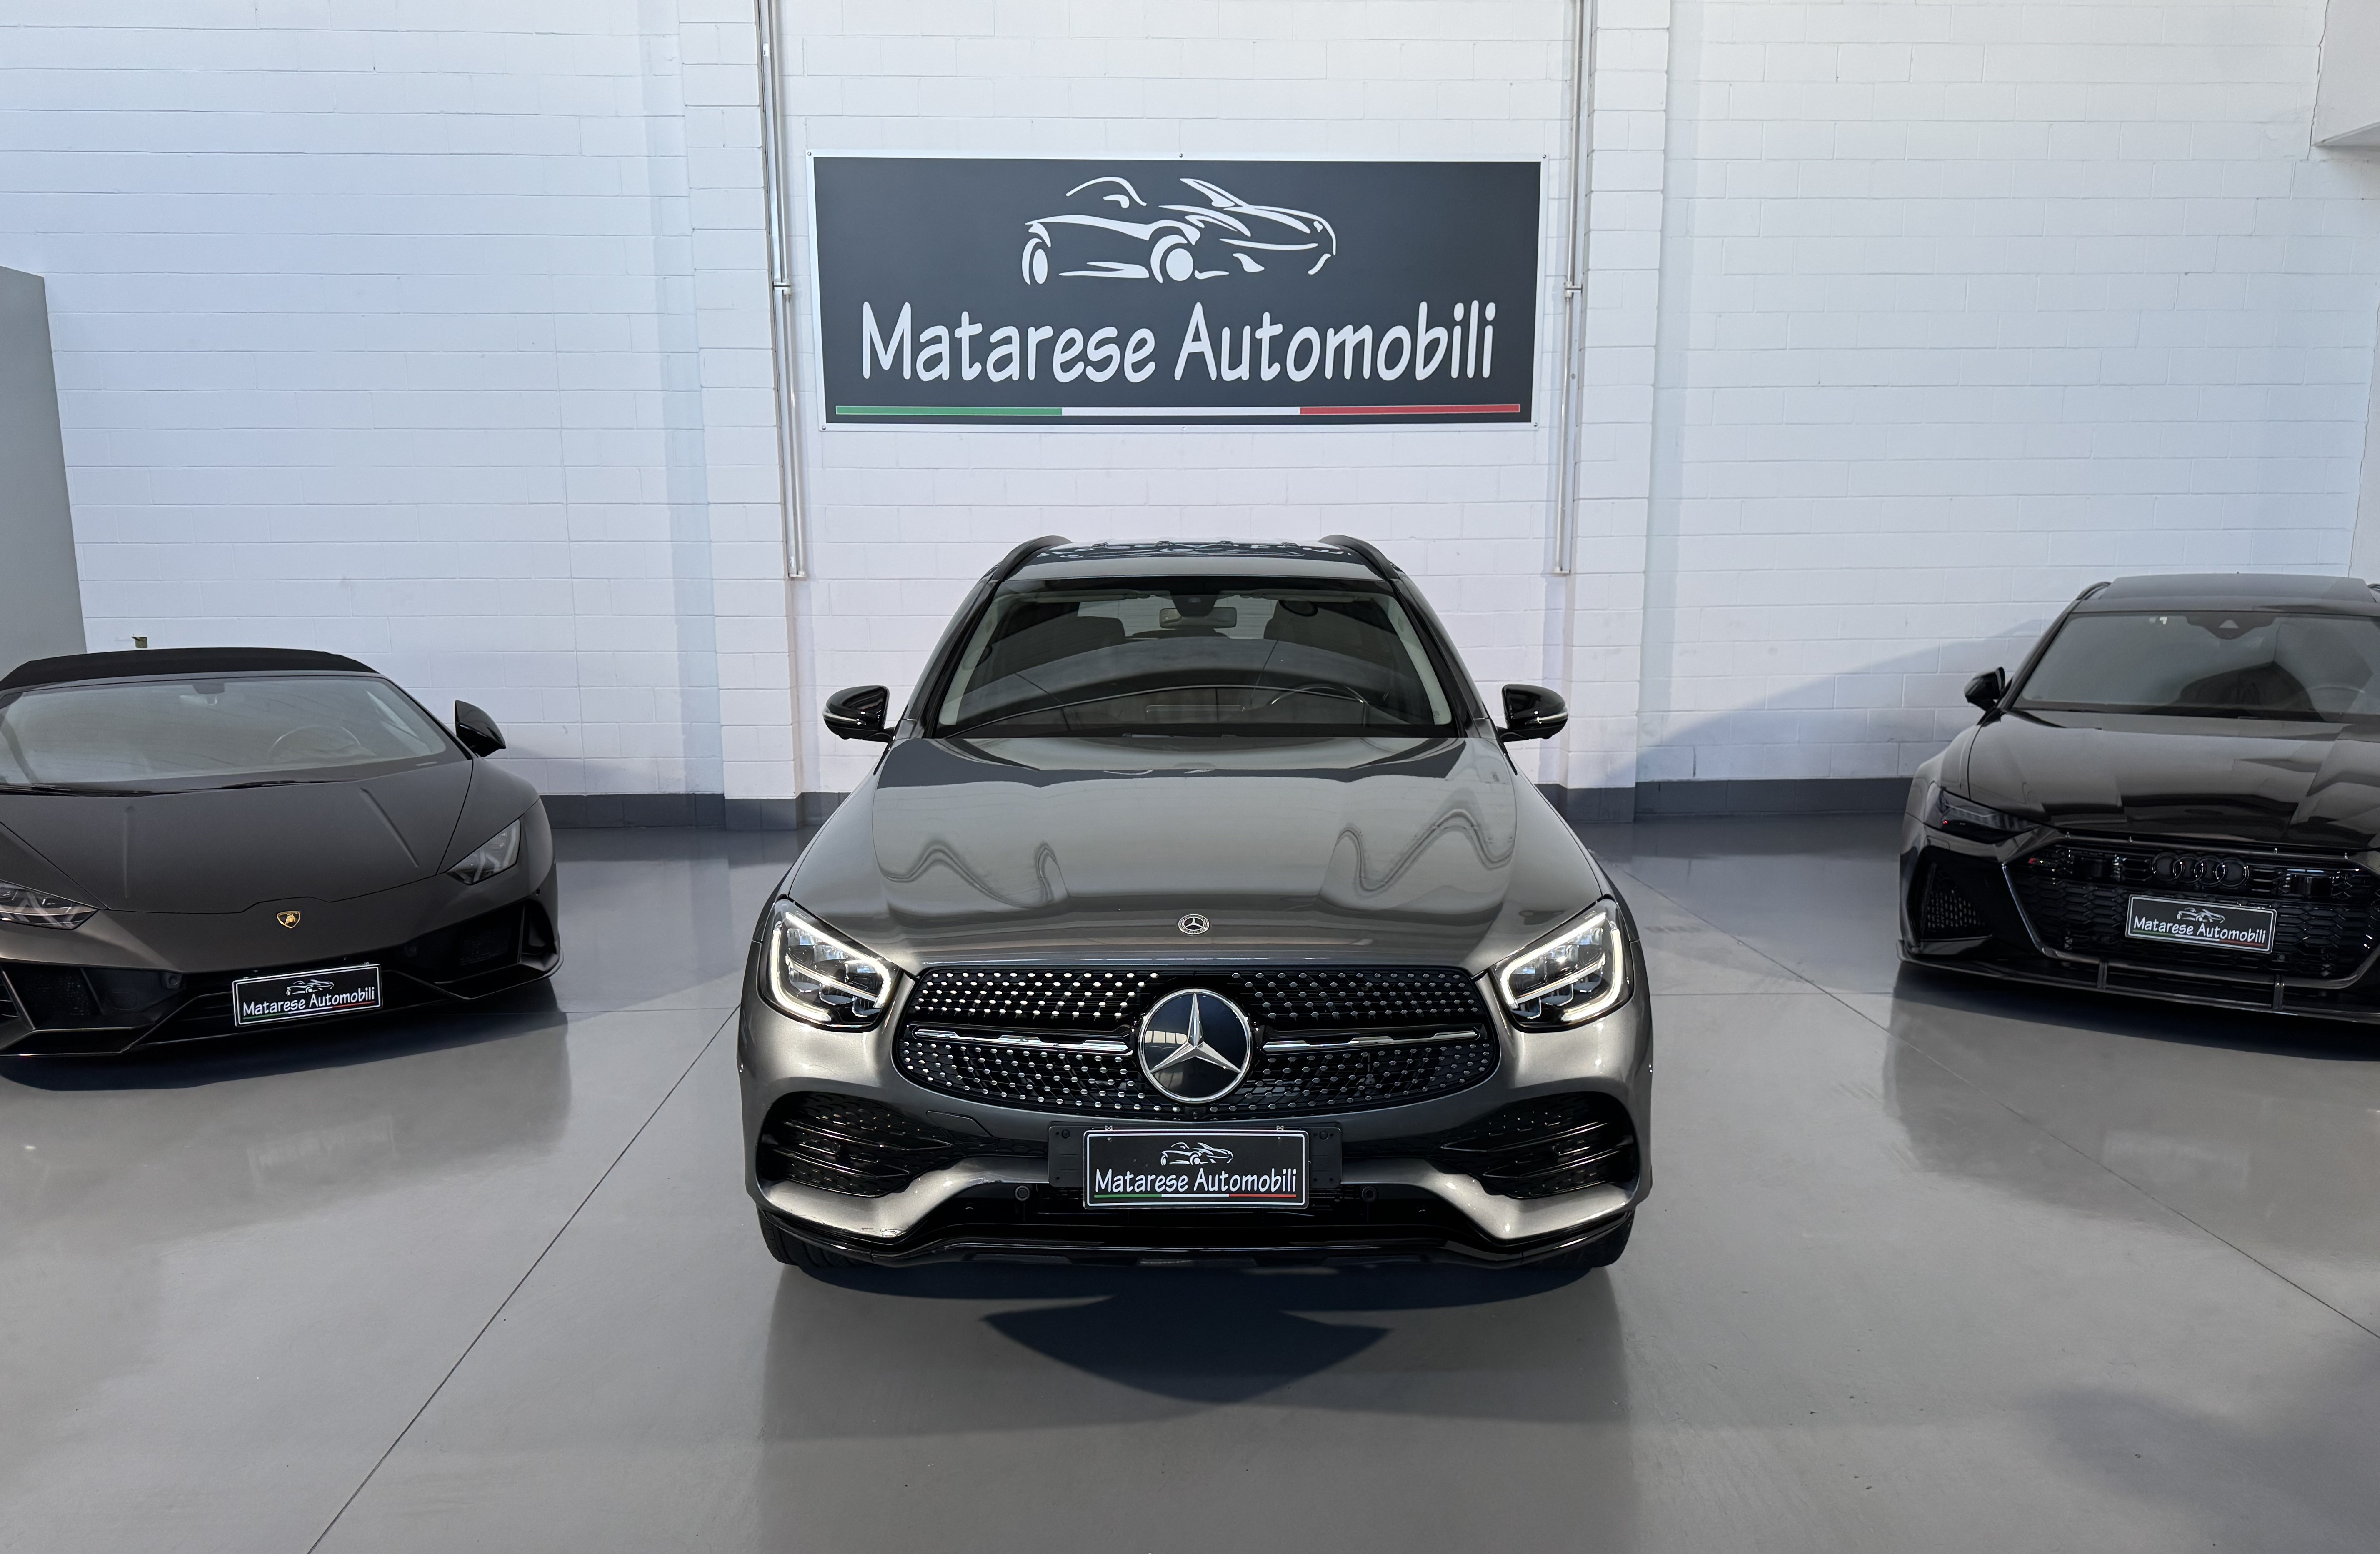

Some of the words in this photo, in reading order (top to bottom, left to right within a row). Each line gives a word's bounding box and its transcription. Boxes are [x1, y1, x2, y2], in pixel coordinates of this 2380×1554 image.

[863, 302, 1155, 382] Matarese
[1175, 300, 1495, 382] Automobili
[2134, 916, 2194, 935] Matarese
[2196, 923, 2266, 943] Automobili
[244, 999, 305, 1016] Matarese
[309, 987, 374, 1008] Automobili
[1096, 1169, 1188, 1192] Matarese
[1194, 1168, 1296, 1192] Automobili
